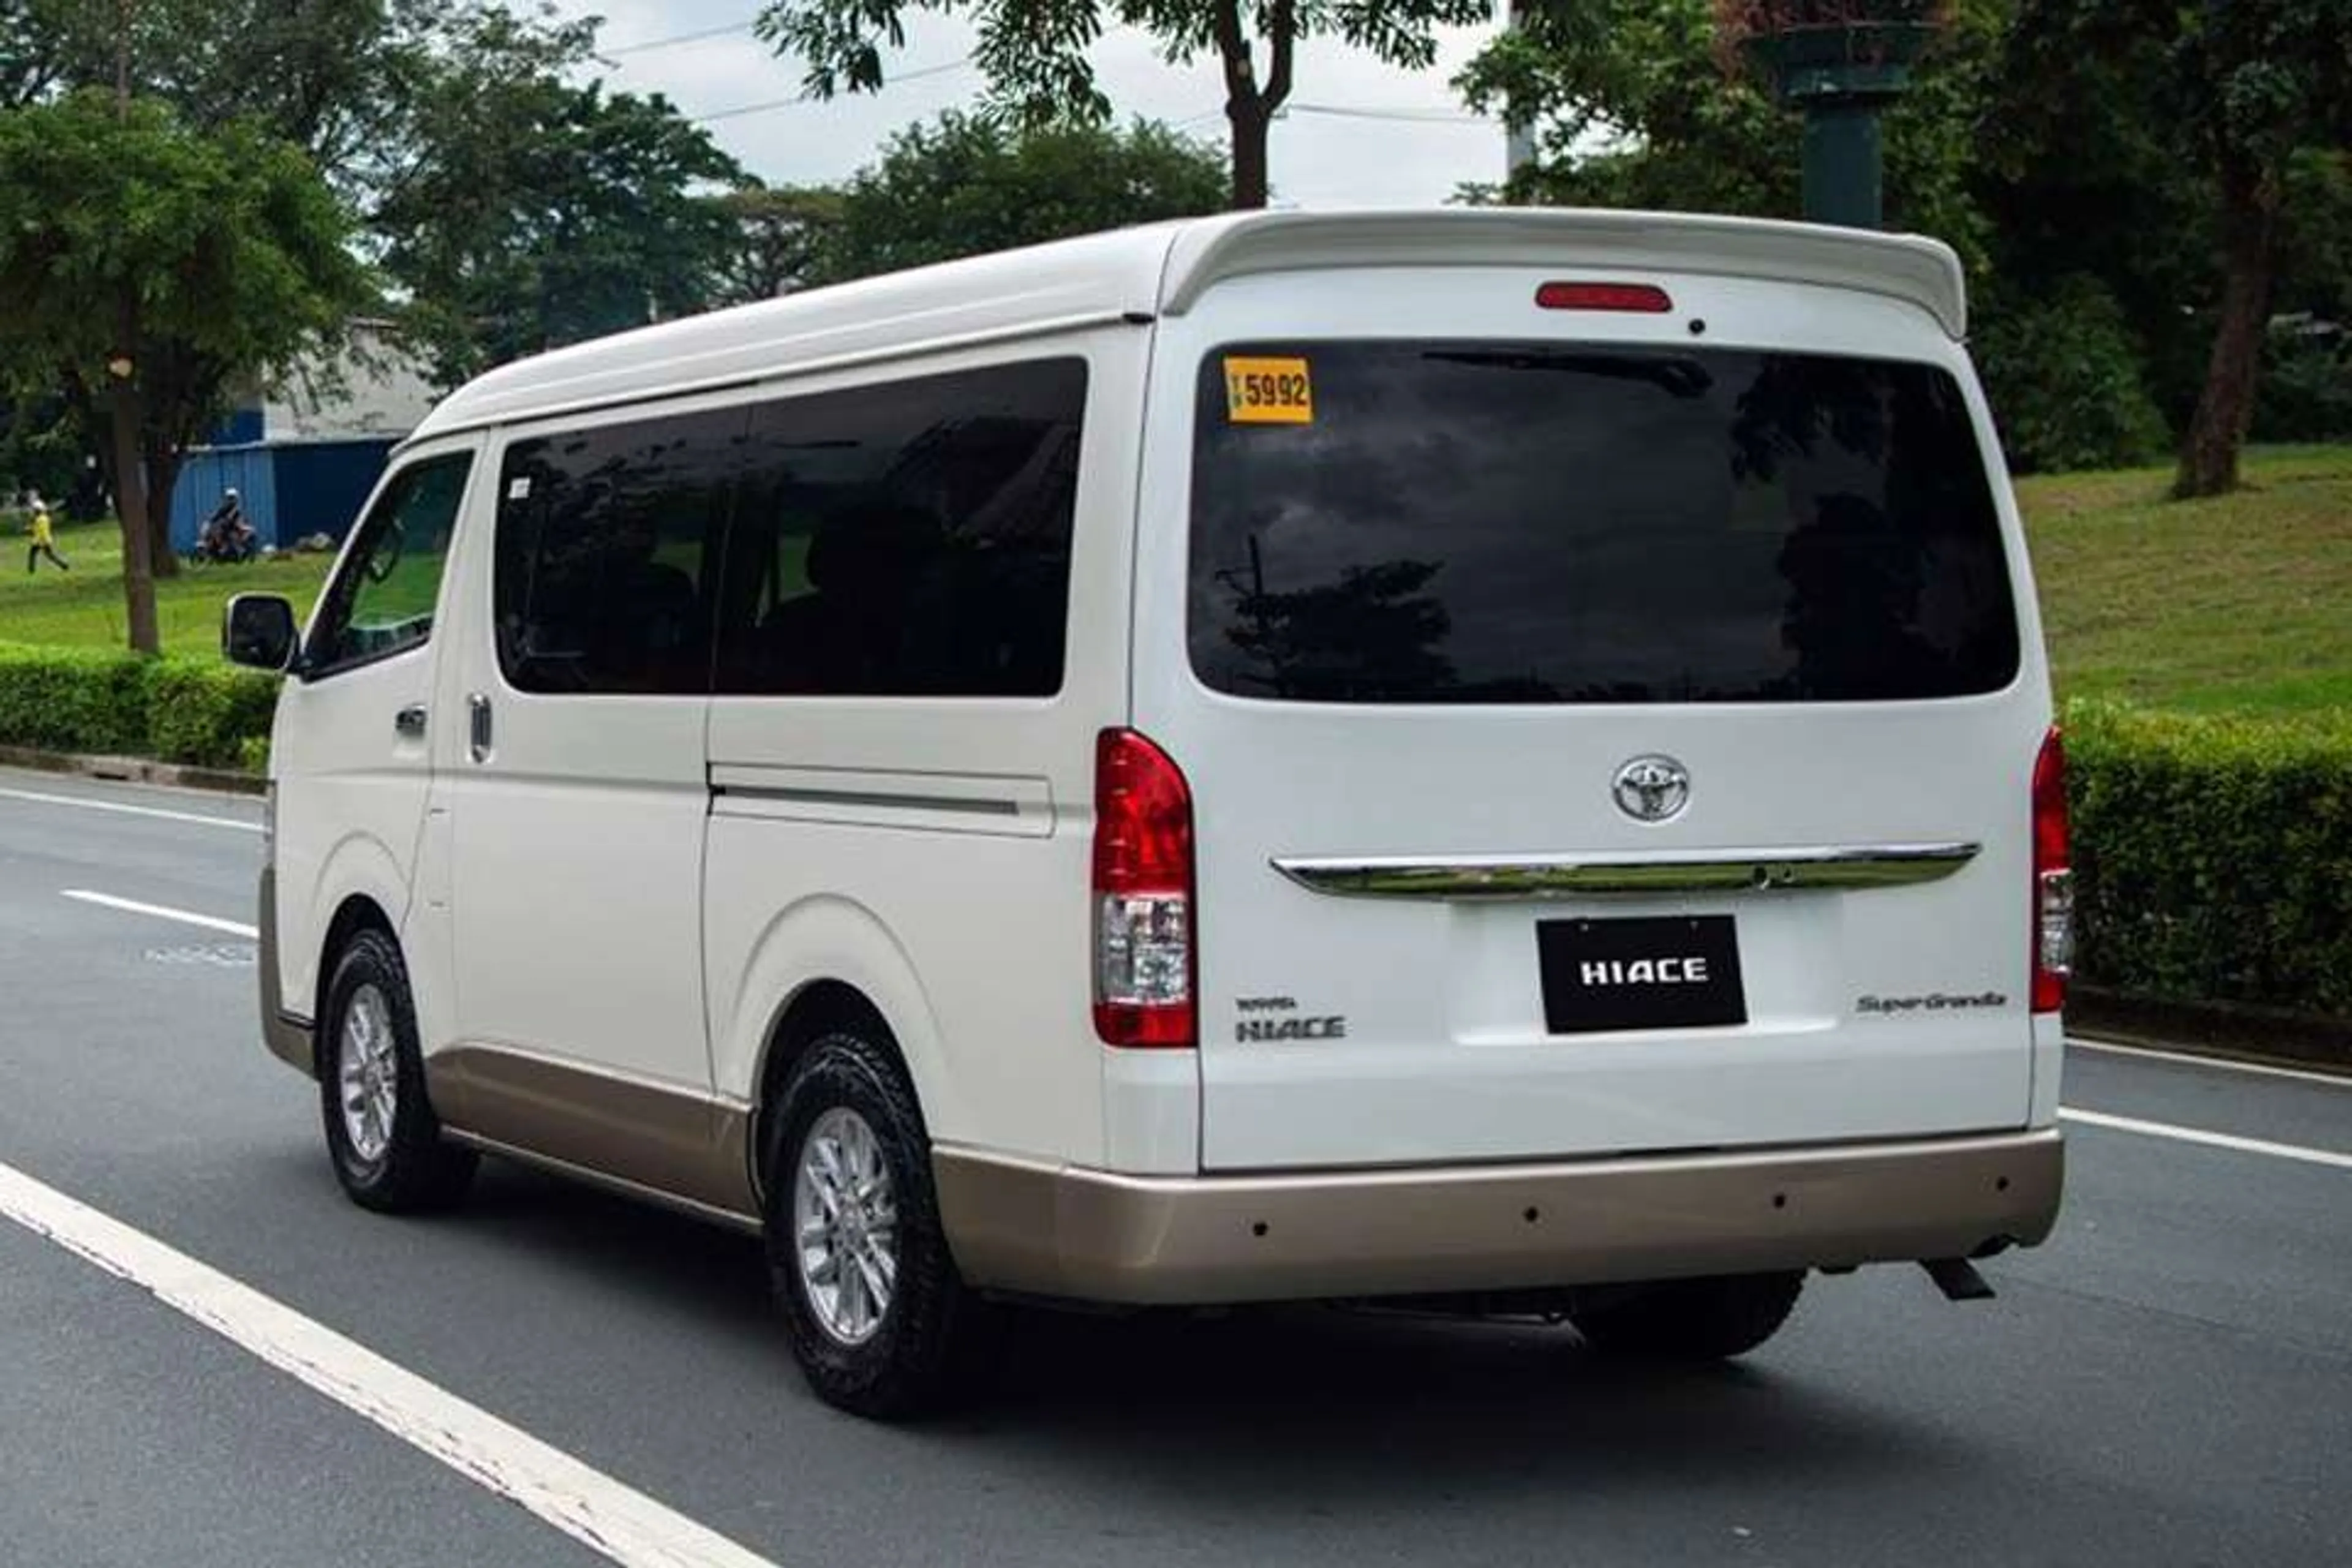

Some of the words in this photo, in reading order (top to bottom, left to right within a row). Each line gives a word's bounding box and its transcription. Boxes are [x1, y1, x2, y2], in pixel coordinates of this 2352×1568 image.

[1246, 374, 1307, 407] 5992
[1580, 957, 1709, 986] HIACE
[1235, 1016, 1347, 1042] HIACE
